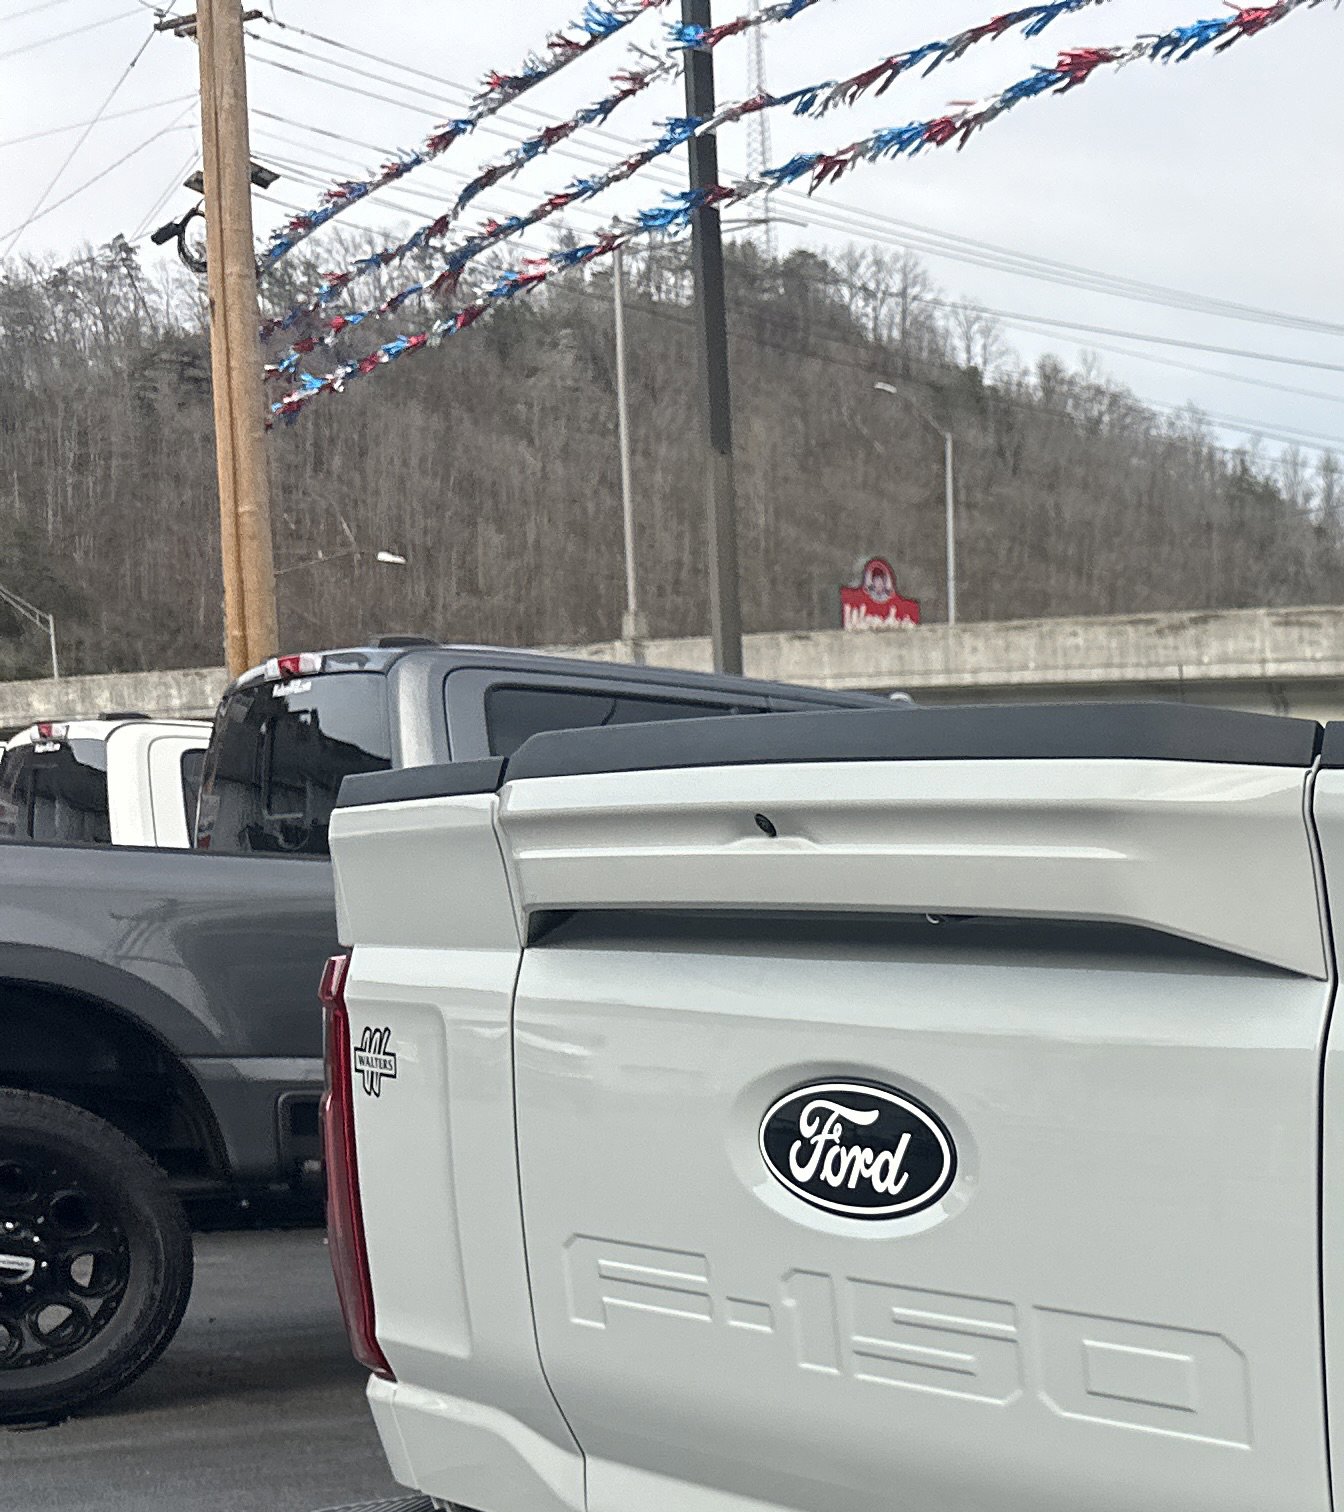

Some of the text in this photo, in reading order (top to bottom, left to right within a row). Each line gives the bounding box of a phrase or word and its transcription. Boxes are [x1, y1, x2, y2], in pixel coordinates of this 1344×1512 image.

[358, 1055, 393, 1071] WALTERS
[788, 1097, 911, 1196] Ford
[562, 1232, 1252, 1451] F-150
